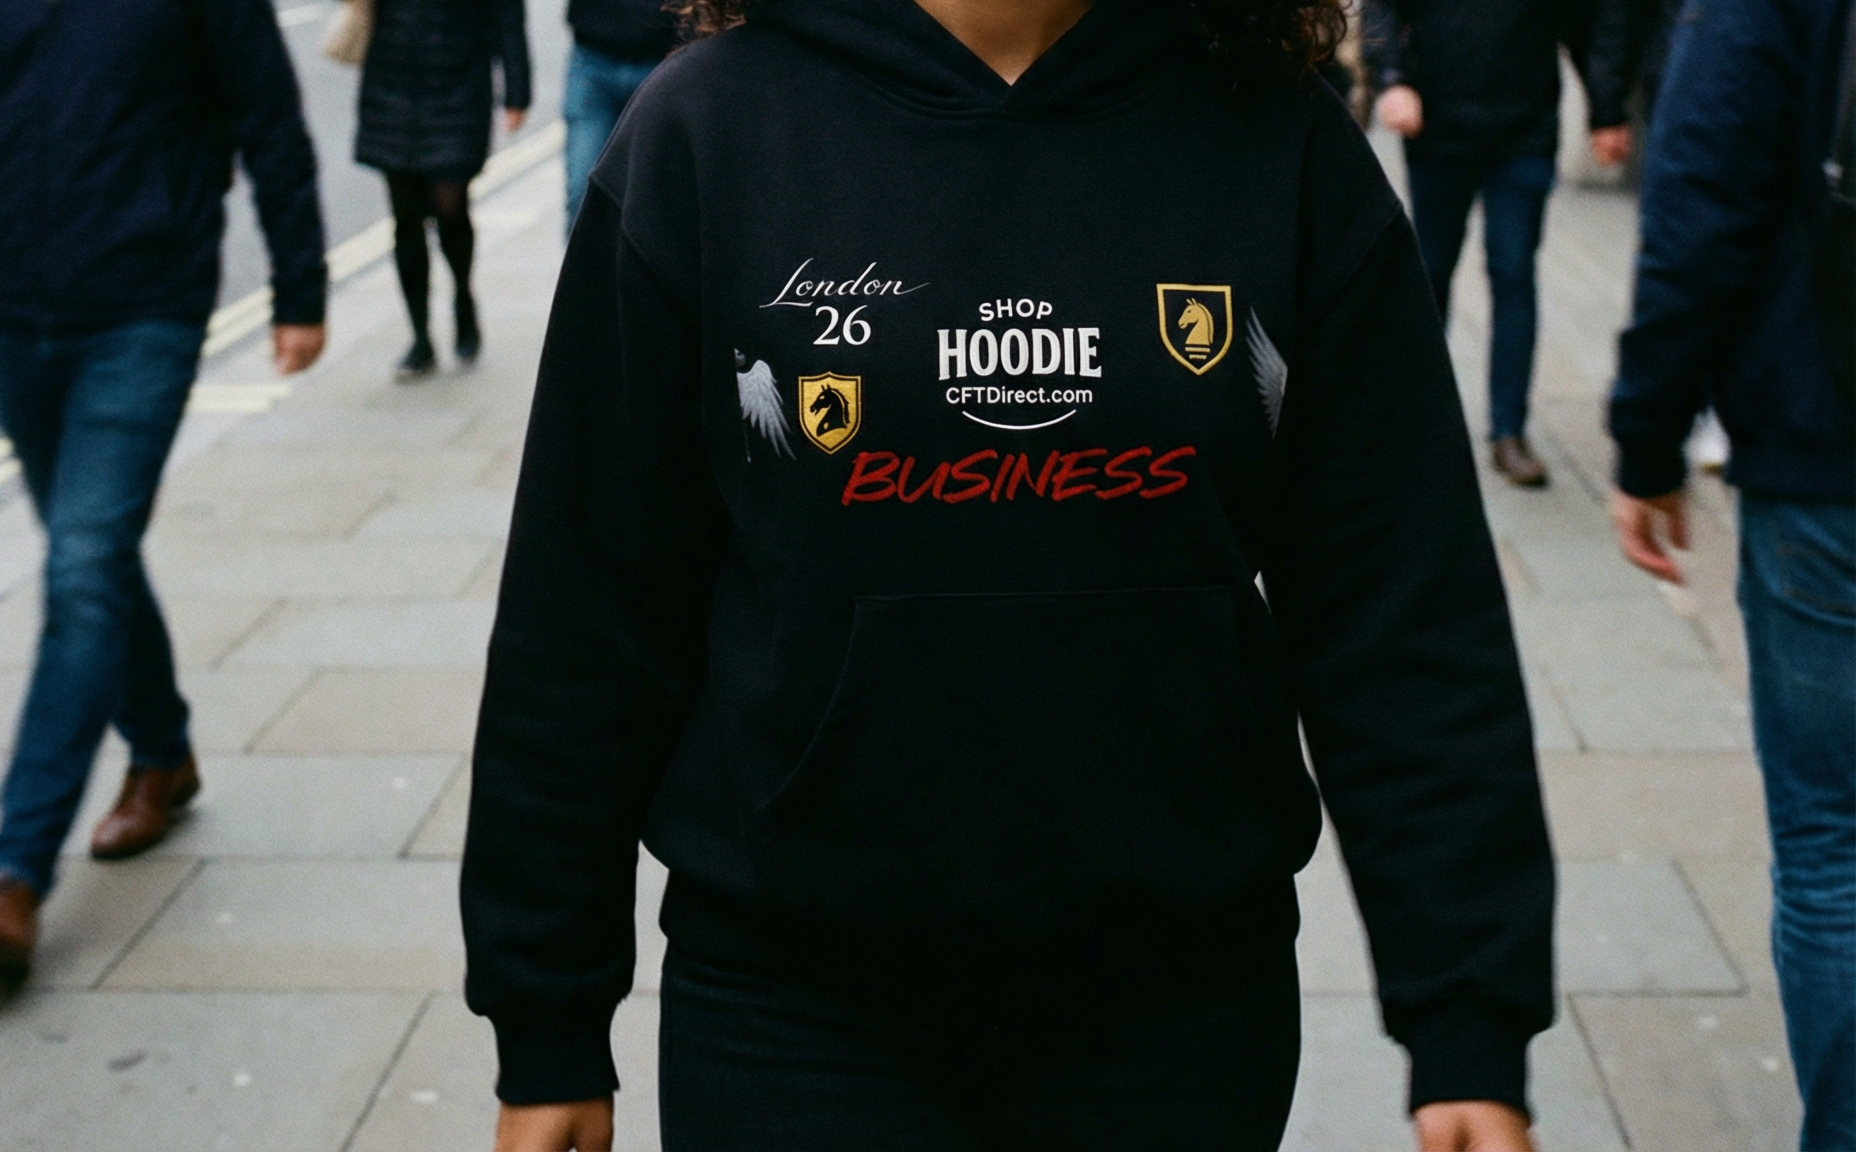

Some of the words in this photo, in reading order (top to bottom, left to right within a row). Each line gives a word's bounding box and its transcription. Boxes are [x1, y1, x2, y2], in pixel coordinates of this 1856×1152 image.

[759, 258, 930, 308] London
[813, 305, 871, 346] 26
[979, 298, 1053, 322] SHOP
[937, 327, 1102, 380] HOODIE
[946, 386, 1093, 404] CFTDirect.com
[841, 447, 1196, 506] BUSINESS
